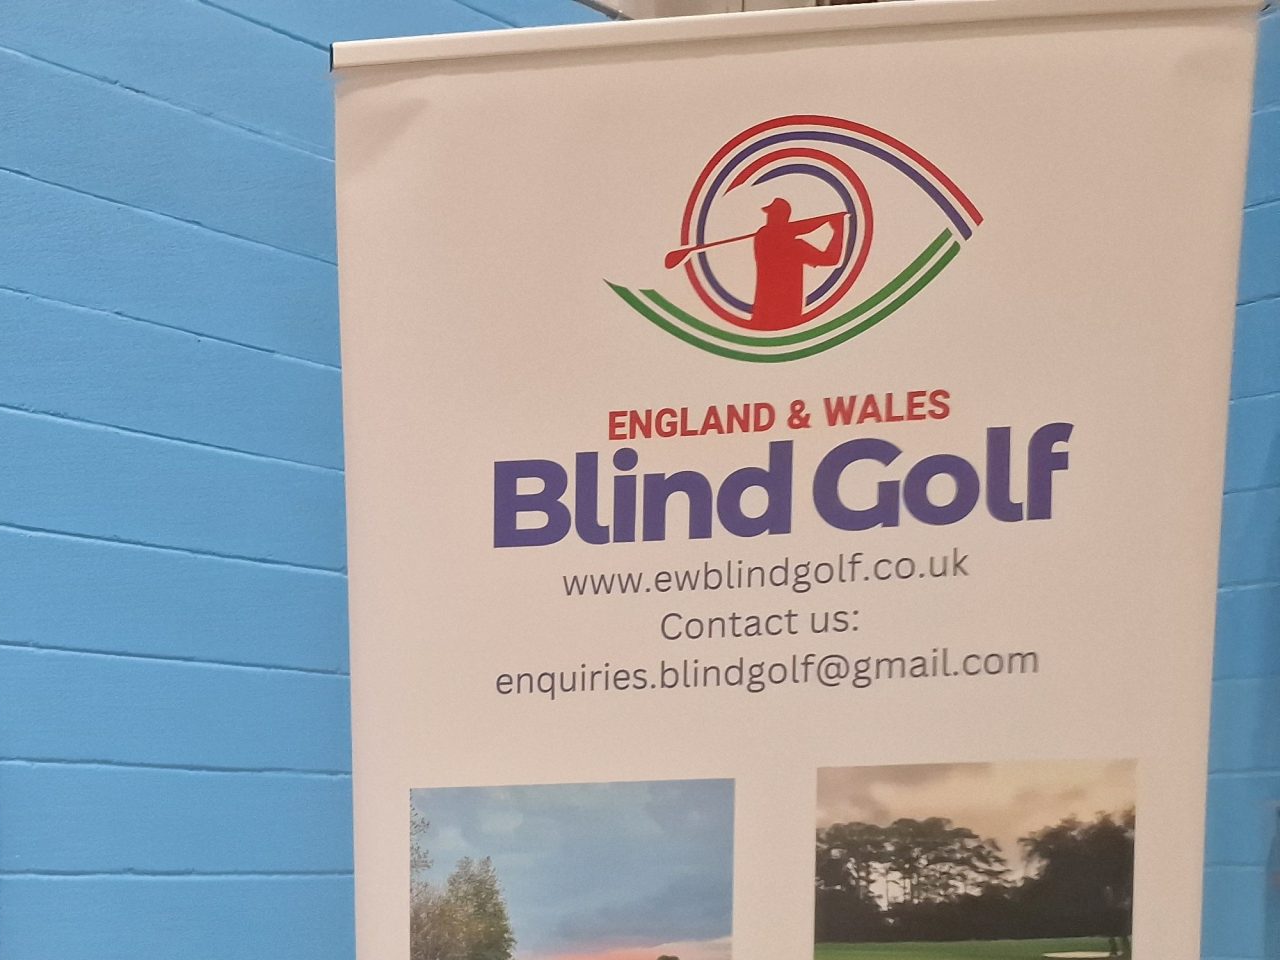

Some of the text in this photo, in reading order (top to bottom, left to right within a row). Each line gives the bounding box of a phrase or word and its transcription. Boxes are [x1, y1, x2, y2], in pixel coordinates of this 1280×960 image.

[608, 389, 951, 440] ENGLAND & WALES
[493, 422, 1075, 548] Blind Golf
[563, 548, 970, 598] www.ewblindgolf.co.uk
[660, 607, 860, 641] Contact us:
[496, 648, 1039, 701] enquiries.blindgolf@gmail.com
